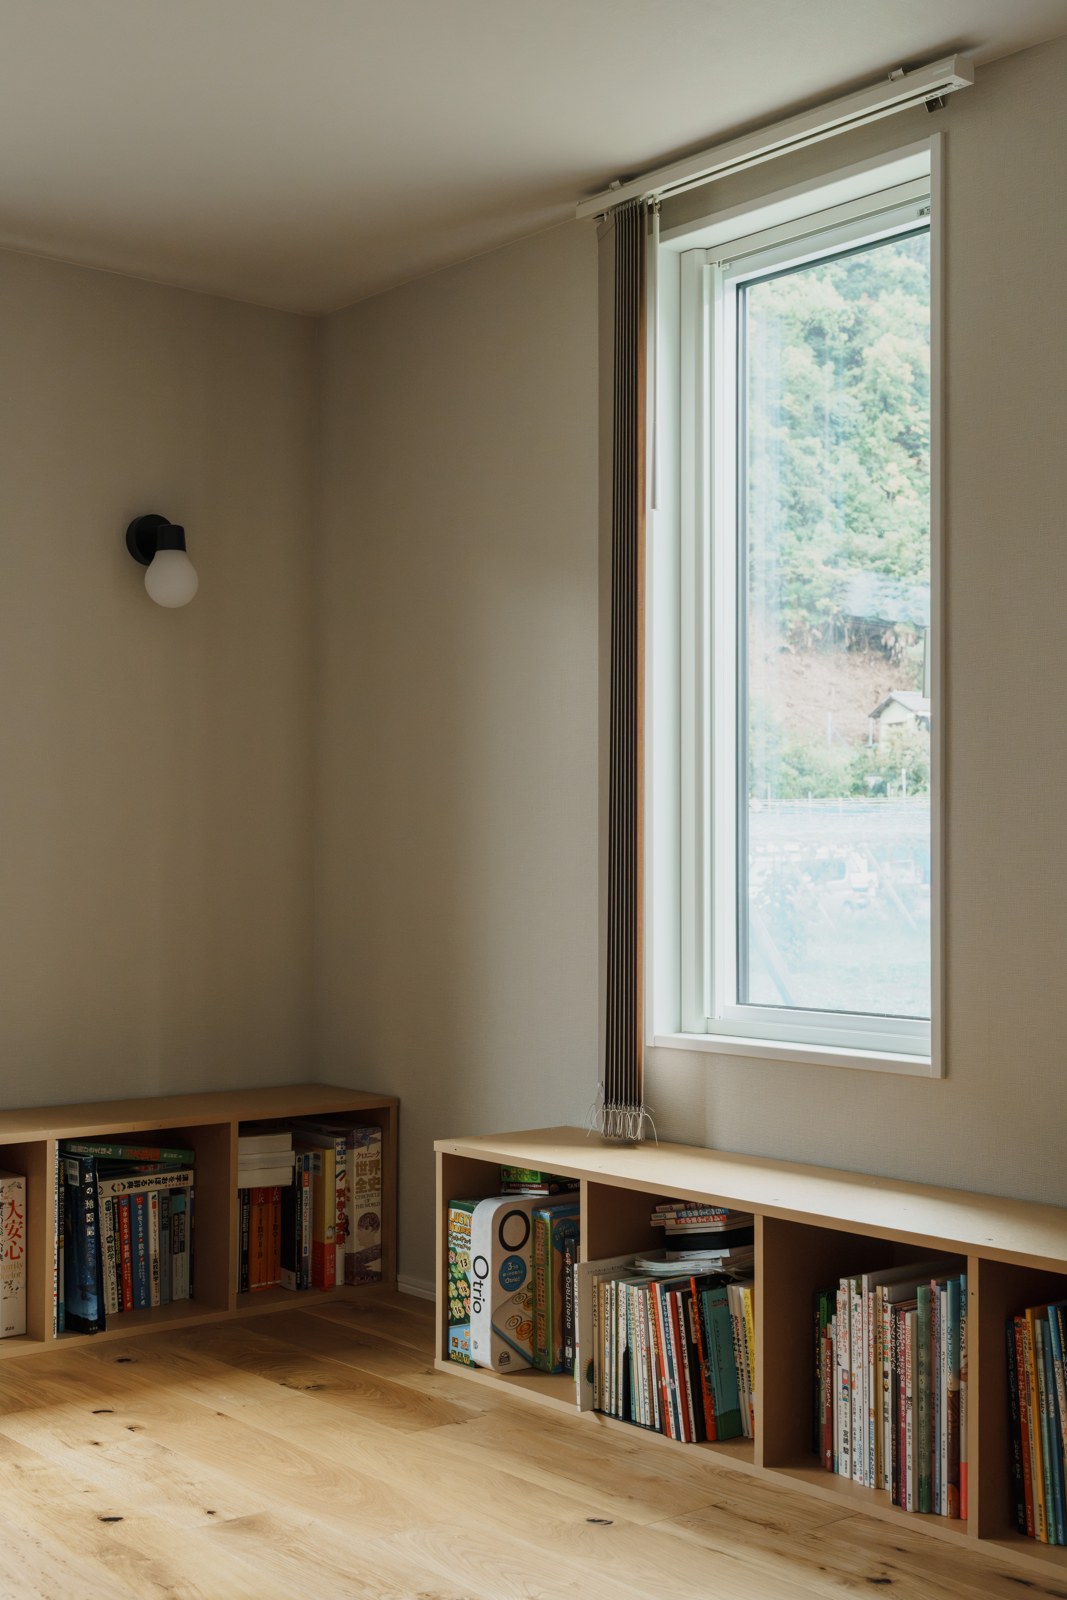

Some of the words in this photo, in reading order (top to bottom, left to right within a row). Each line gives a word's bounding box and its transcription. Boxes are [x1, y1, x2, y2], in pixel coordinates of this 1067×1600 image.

[356, 1160, 380, 1178] 世界
[355, 1176, 380, 1195] 全史
[448, 1210, 471, 1227] LUCKY
[4, 1200, 23, 1261] 大安心
[460, 1259, 468, 1267] 13
[473, 1255, 489, 1314] Otrio
